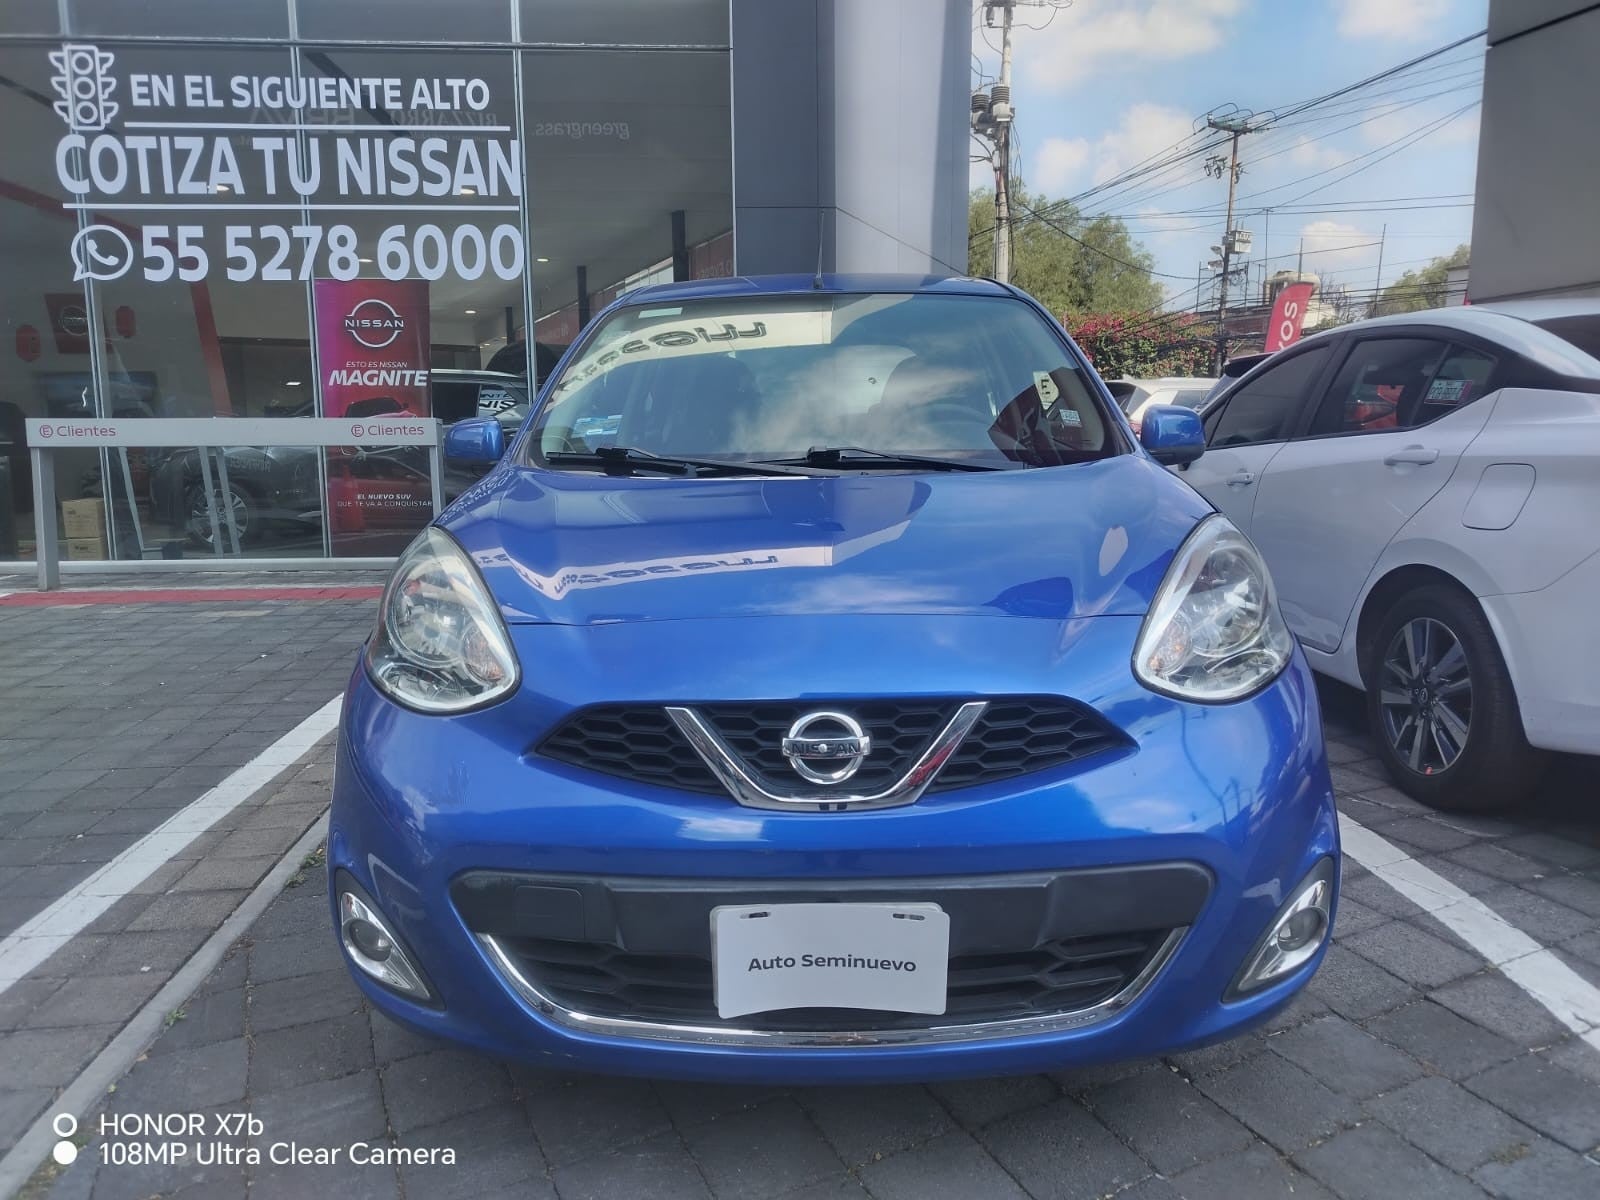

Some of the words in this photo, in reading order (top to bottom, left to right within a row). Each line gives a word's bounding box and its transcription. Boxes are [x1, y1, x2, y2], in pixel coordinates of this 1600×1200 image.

[131, 74, 174, 107] EN
[186, 75, 223, 108] EL
[231, 76, 402, 110] SIGUIENTE
[411, 78, 490, 111] ALTO
[56, 135, 245, 195] COTIZA
[253, 138, 321, 196] TU
[338, 138, 521, 197] NISSAN
[142, 225, 208, 282] 55
[226, 225, 360, 282] 5278
[377, 224, 524, 281] 6000
[345, 319, 404, 328] NISSAN
[328, 369, 429, 387] MAGNITE
[57, 425, 116, 437] Clientes
[368, 424, 425, 436] Clientes
[748, 955, 796, 972] Auto
[801, 954, 917, 972] Seminuevo
